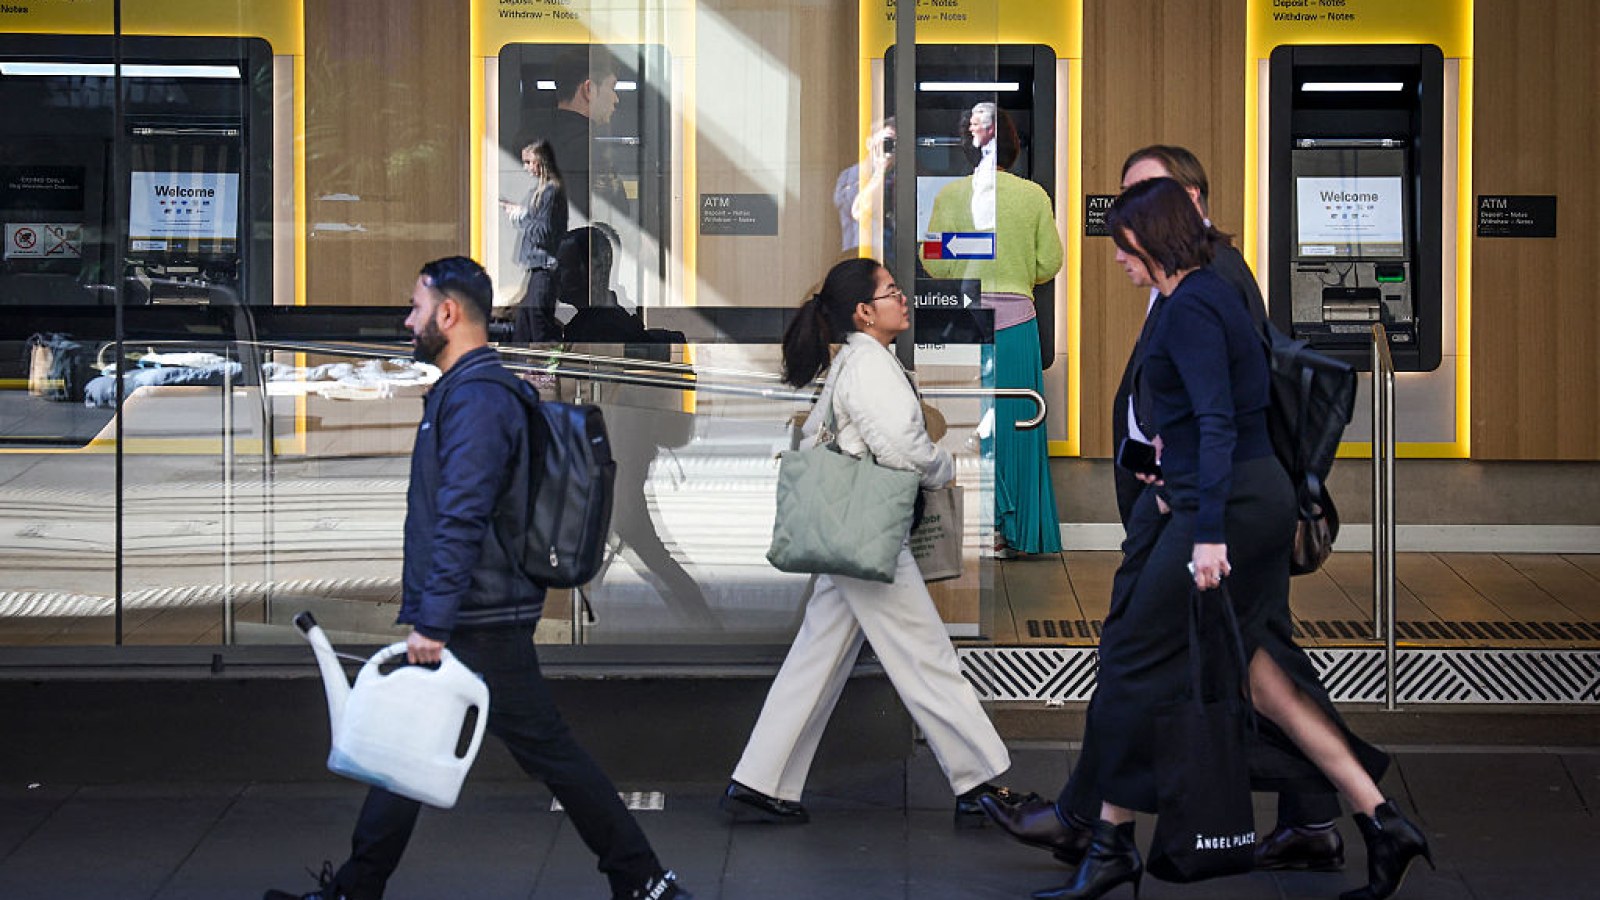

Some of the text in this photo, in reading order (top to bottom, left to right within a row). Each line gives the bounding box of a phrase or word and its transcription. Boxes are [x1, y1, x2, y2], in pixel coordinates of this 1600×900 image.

[0, 4, 29, 13] Notes
[1273, 0, 1308, 8] Deposit
[499, 10, 542, 18] Withdraw
[552, 10, 579, 19] Notes
[940, 12, 967, 20] Notes
[1273, 12, 1317, 20] Withdraw
[1327, 12, 1355, 20] Notes
[154, 185, 215, 197] Welcome
[1319, 191, 1379, 202] Welcome
[704, 197, 729, 207] ATM
[1089, 198, 1115, 208] ATM
[1481, 198, 1507, 208] ATM
[1233, 832, 1256, 847] PLACE
